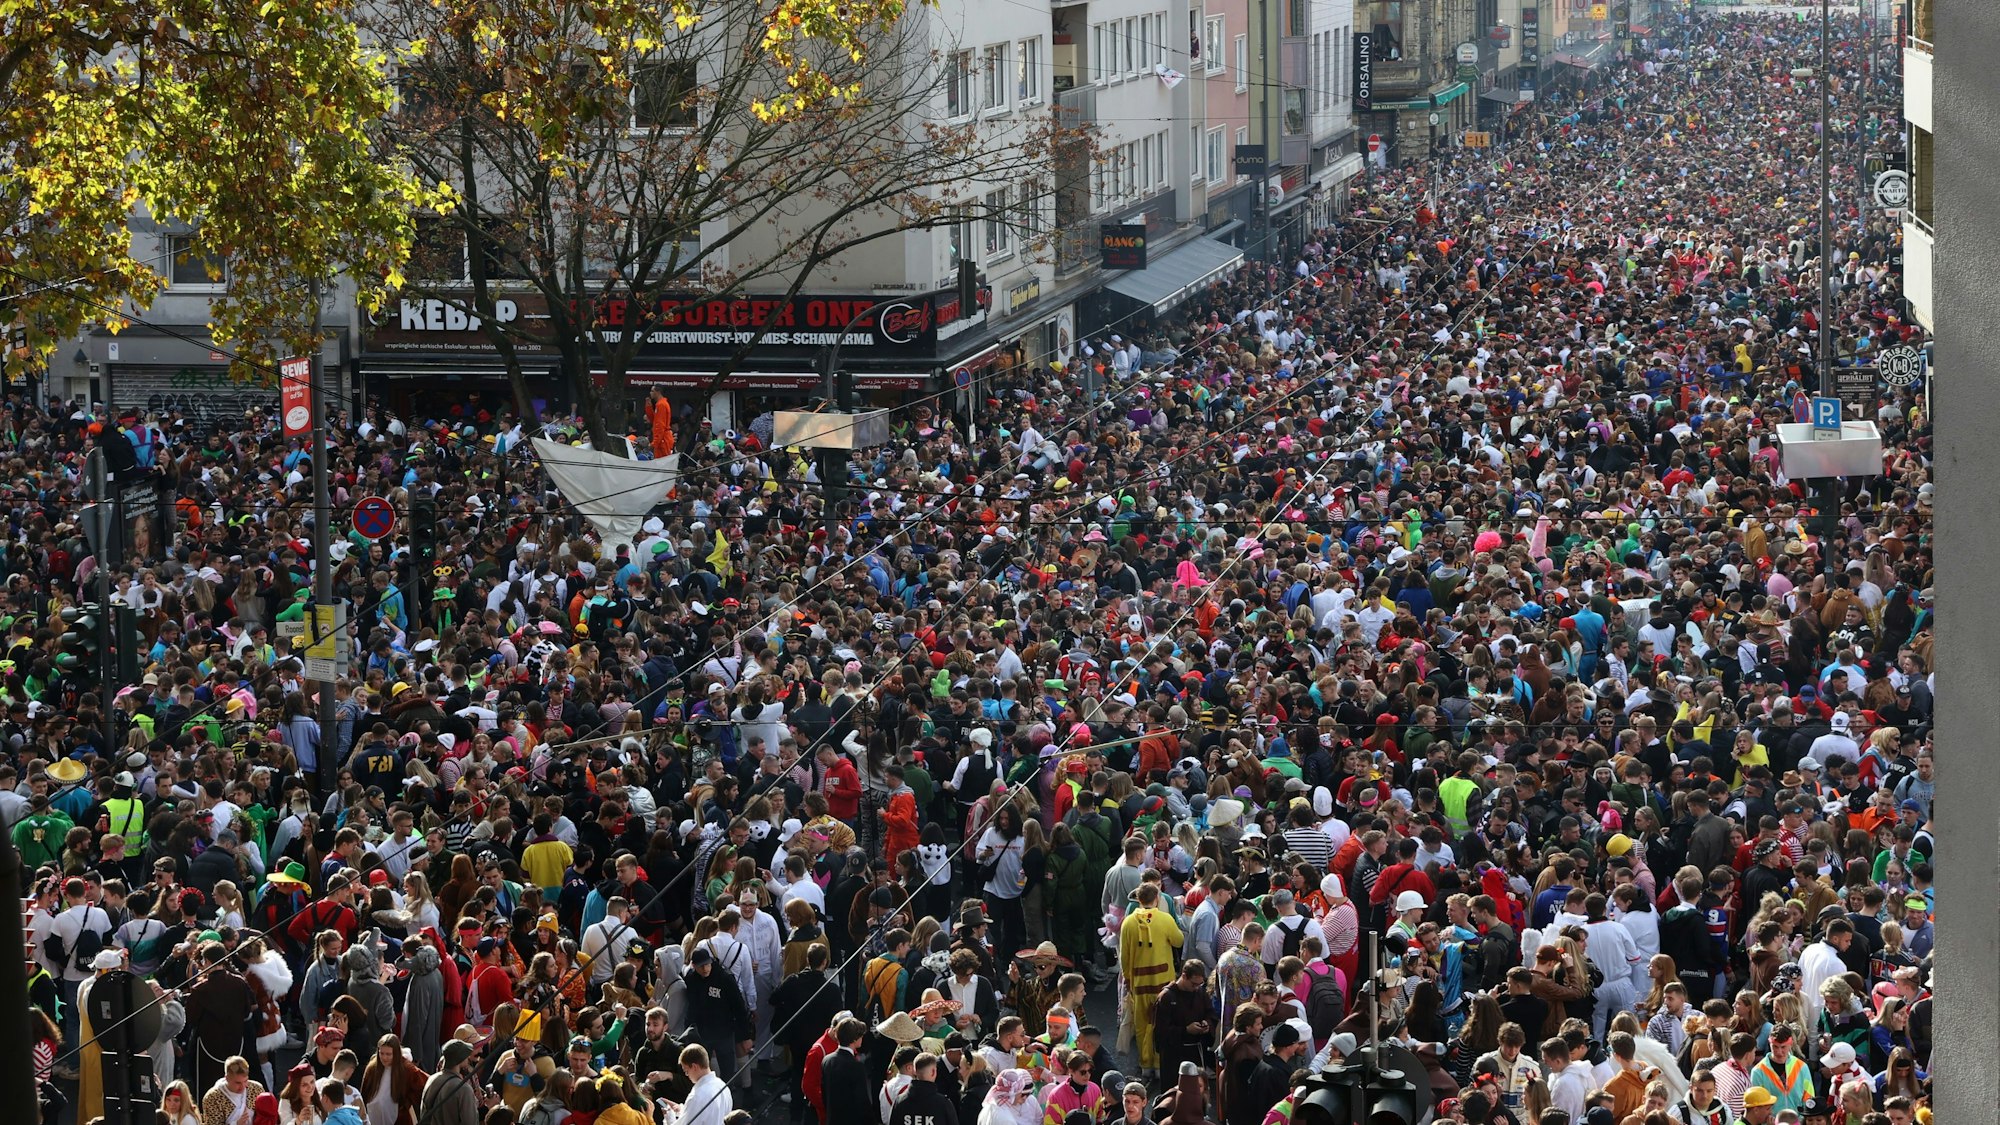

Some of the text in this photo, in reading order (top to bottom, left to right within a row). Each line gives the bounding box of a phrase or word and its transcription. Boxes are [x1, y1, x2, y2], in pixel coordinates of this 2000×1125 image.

[1236, 156, 1264, 164] duma
[660, 300, 796, 327] BURGER
[806, 300, 874, 327] ONE
[884, 301, 931, 333] Beef
[1882, 347, 1917, 363] FRISEUR
[281, 360, 309, 379] REWE
[1892, 358, 1908, 373] K&B
[1882, 369, 1918, 384] 9383320
[1819, 402, 1834, 425] P
[368, 755, 393, 773] FBI
[1708, 909, 1719, 923] 9
[708, 986, 721, 998] SEK
[904, 1114, 935, 1125] SEK
